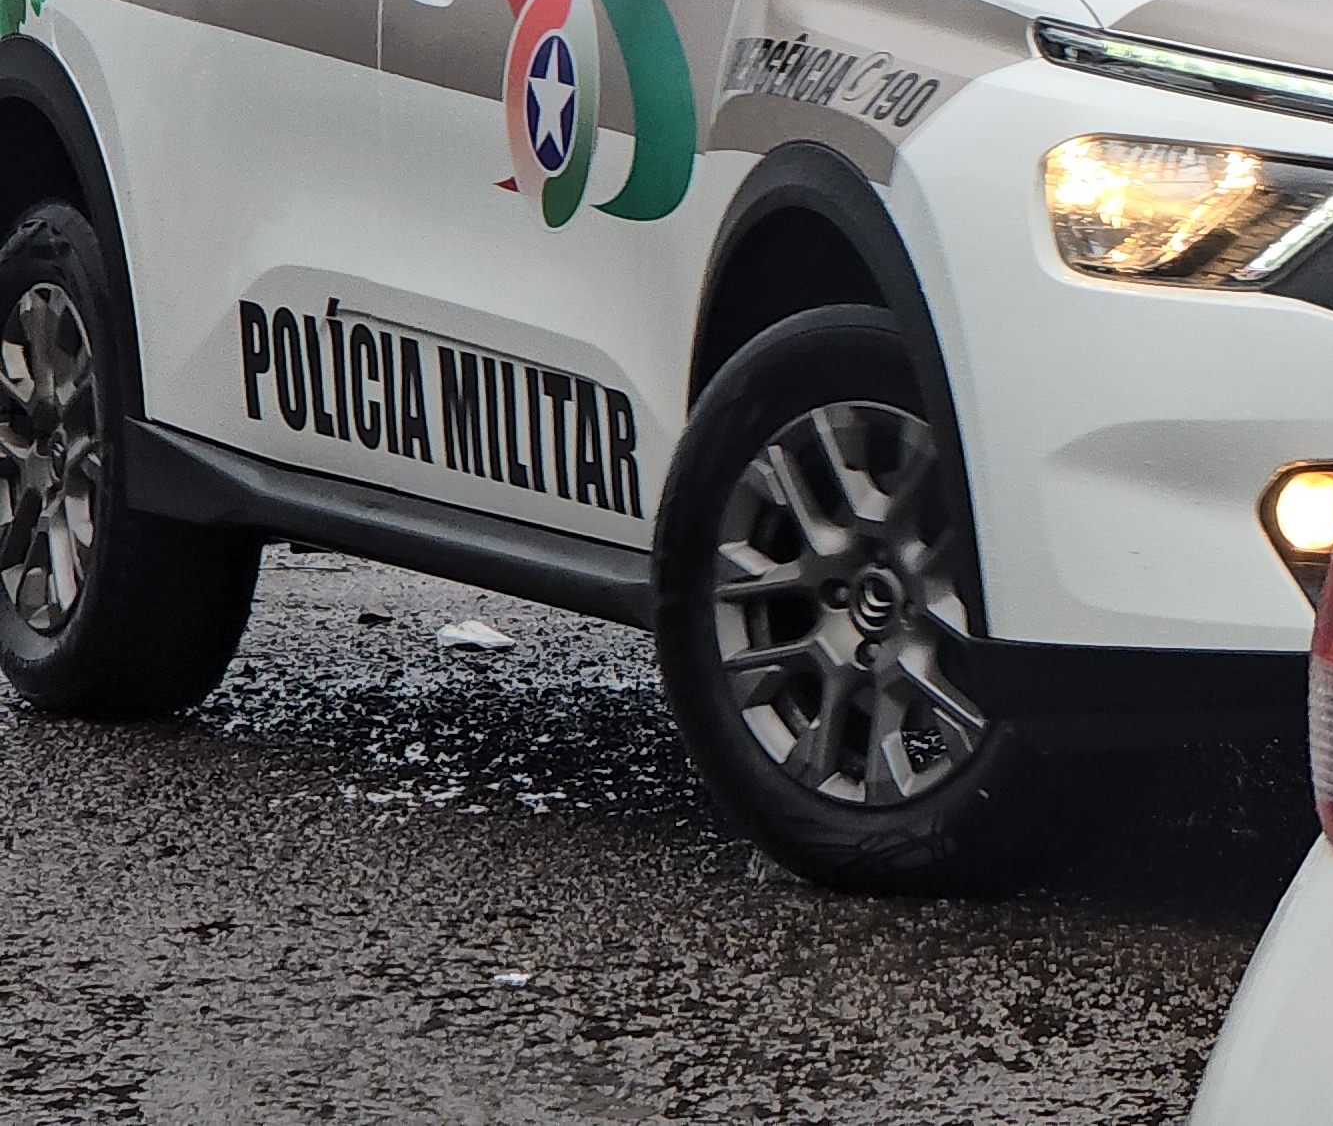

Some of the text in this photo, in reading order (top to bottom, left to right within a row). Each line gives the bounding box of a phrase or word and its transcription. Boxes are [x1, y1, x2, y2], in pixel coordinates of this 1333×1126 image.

[861, 69, 940, 127] 190
[239, 297, 645, 519] POLÍCIA MILITAR
